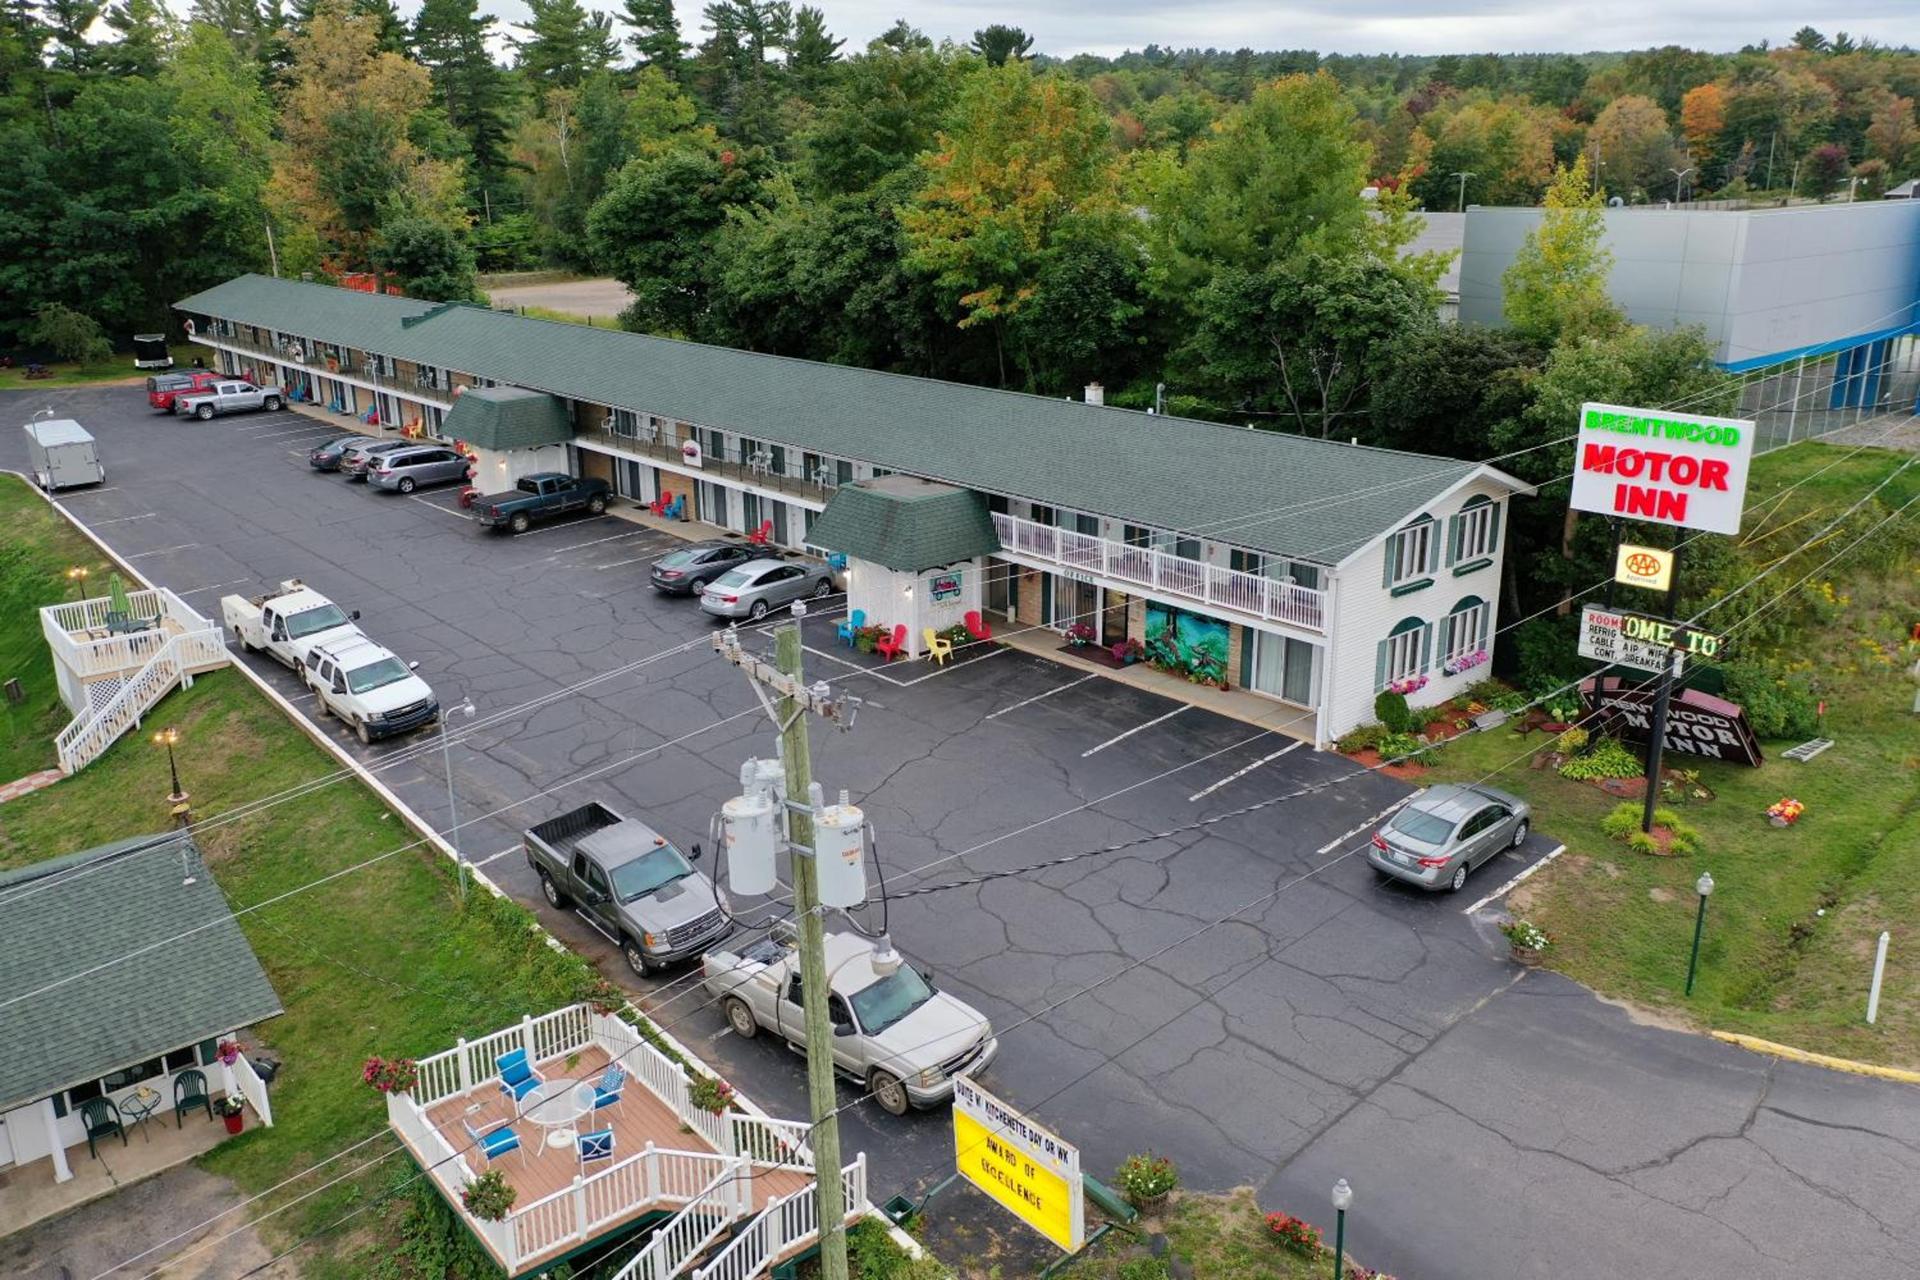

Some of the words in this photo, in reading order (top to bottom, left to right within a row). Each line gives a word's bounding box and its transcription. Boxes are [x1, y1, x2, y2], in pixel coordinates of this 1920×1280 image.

[1585, 410, 1741, 447] BRENTWOOD
[1582, 443, 1730, 492] MOTOR
[1613, 483, 1689, 522] INN
[1589, 624, 1617, 638] REFRIG
[1590, 635, 1615, 648] CABLE
[1687, 630, 1718, 657] TO
[986, 1136, 1017, 1167] AWARD
[1024, 1163, 1035, 1180] OF
[1028, 1129, 1044, 1147] DAY
[1045, 1139, 1056, 1155] OR
[1057, 1144, 1069, 1164] WK
